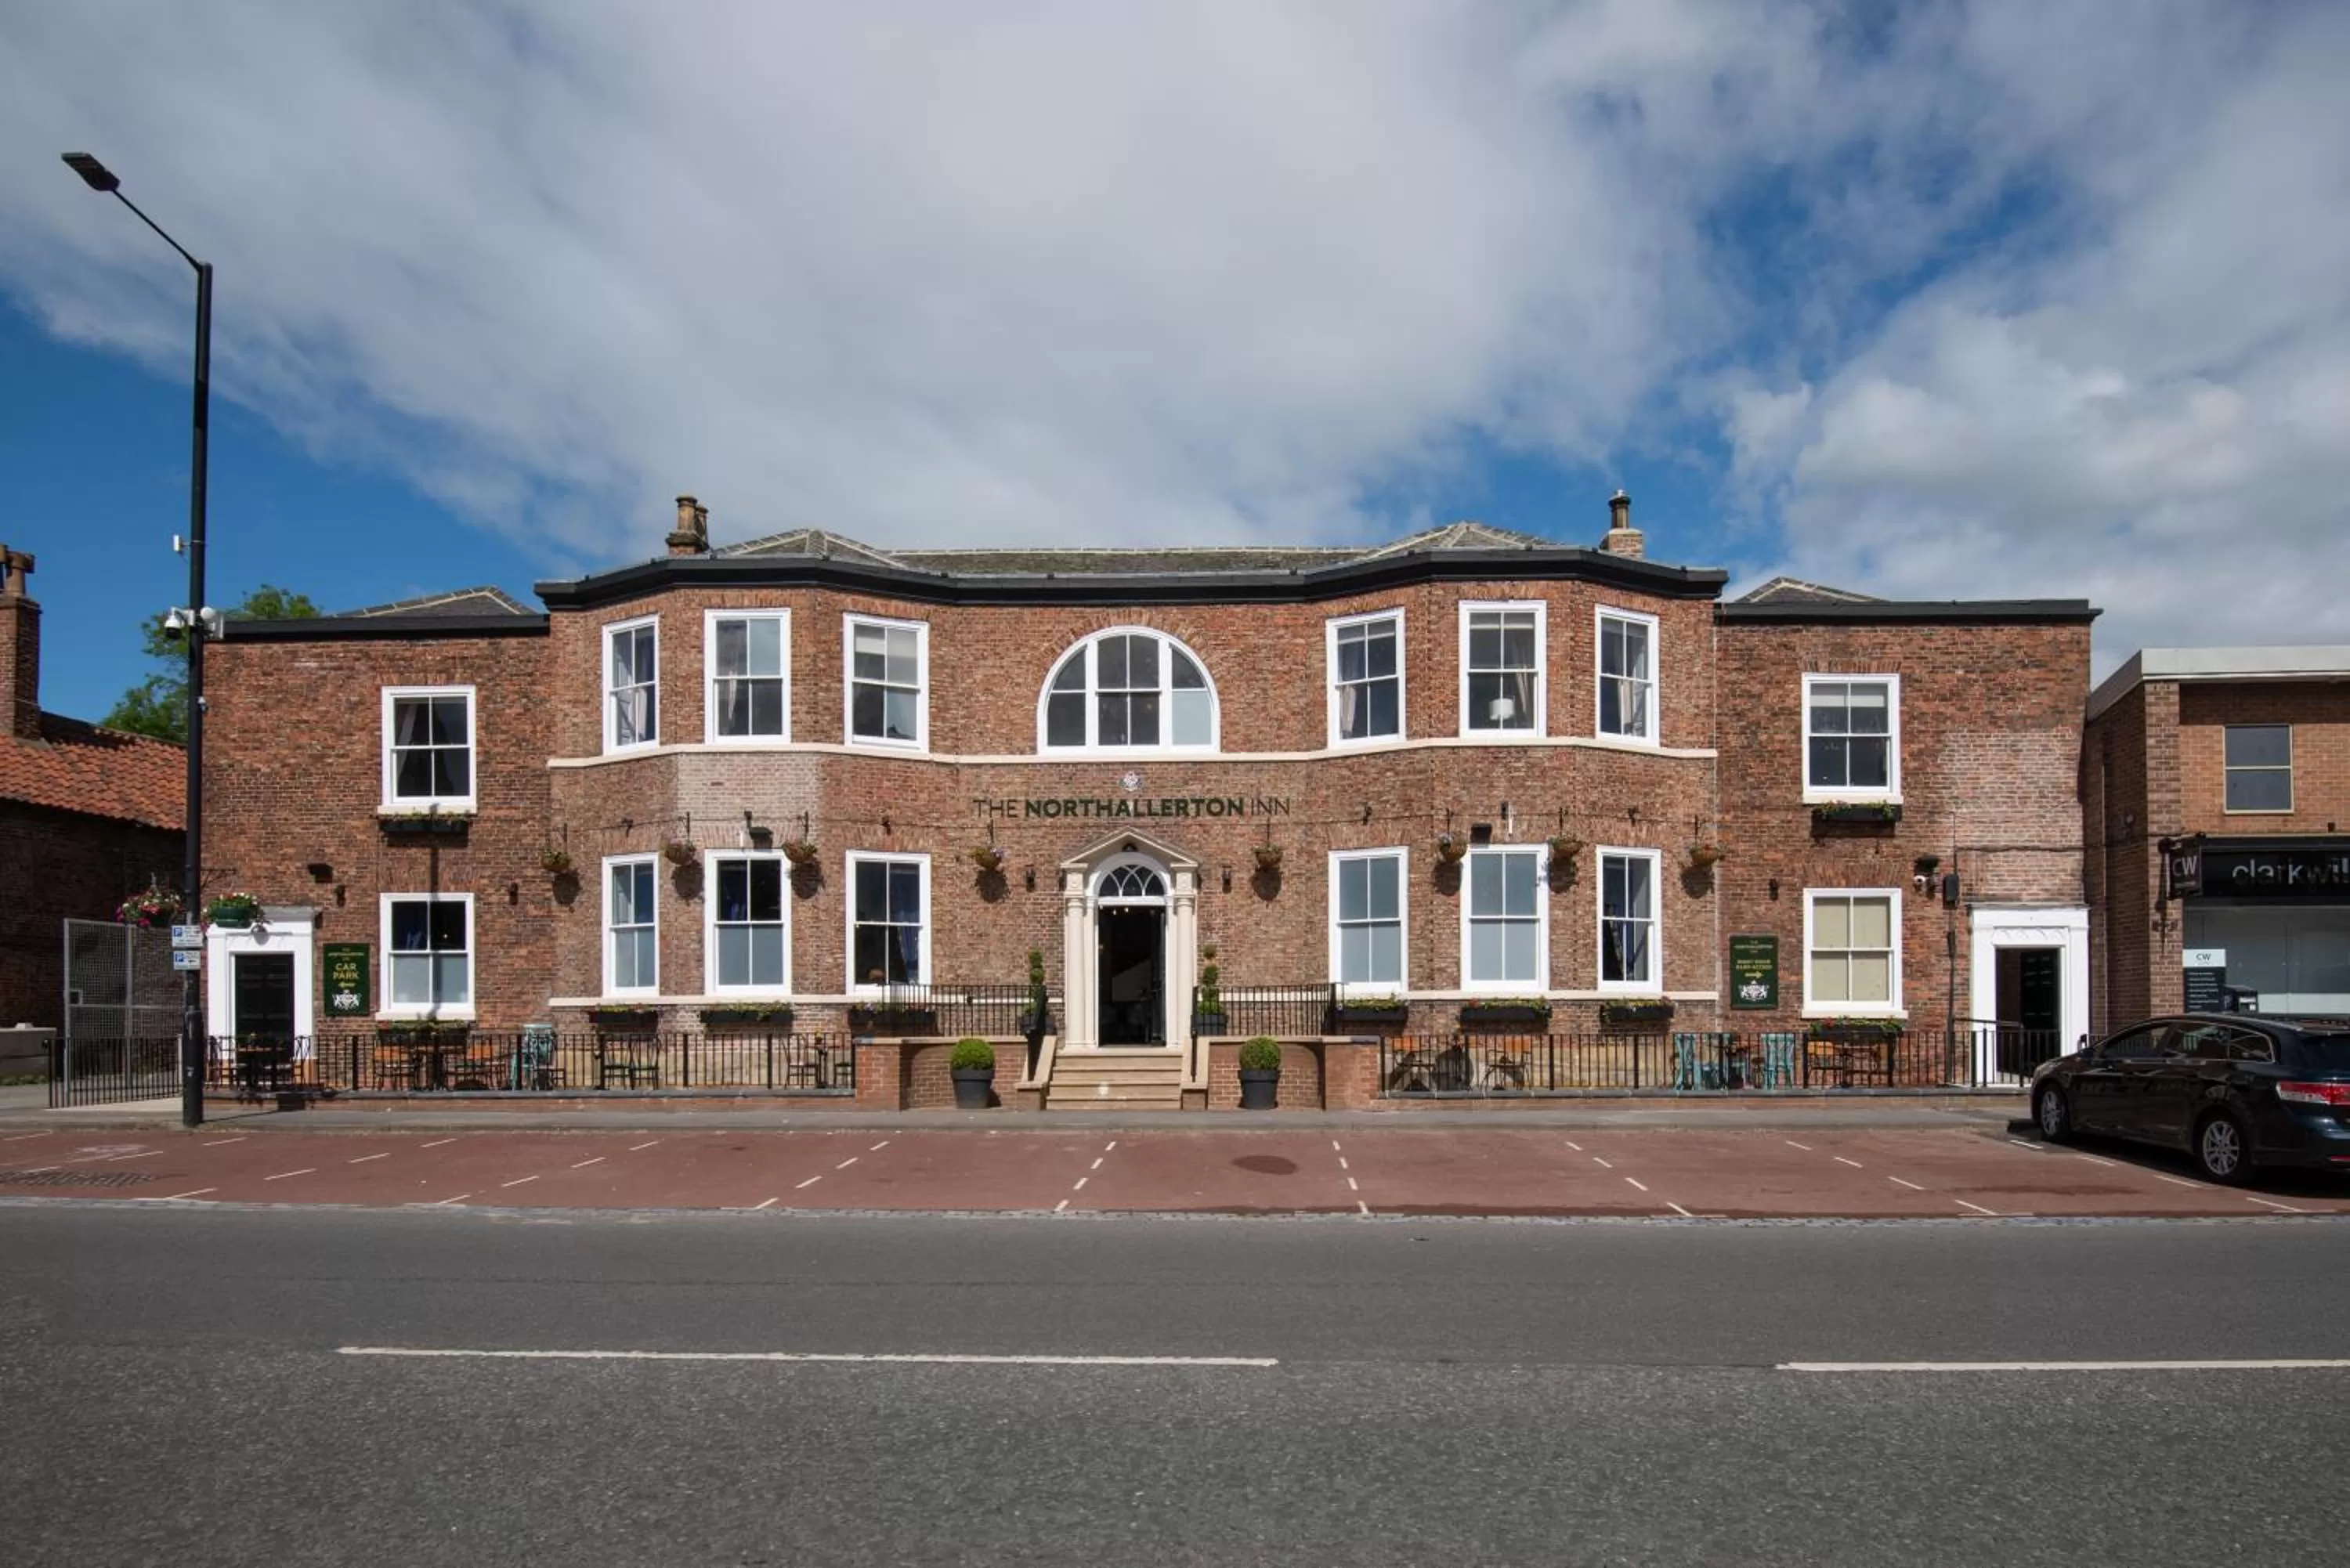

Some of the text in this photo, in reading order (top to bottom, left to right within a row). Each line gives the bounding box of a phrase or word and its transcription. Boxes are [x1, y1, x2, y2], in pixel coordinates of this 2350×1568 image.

[973, 797, 1291, 818] THE NORTHALLERTON INN
[2172, 855, 2197, 877] CW
[335, 963, 357, 971] CAR
[333, 971, 360, 981] PARK
